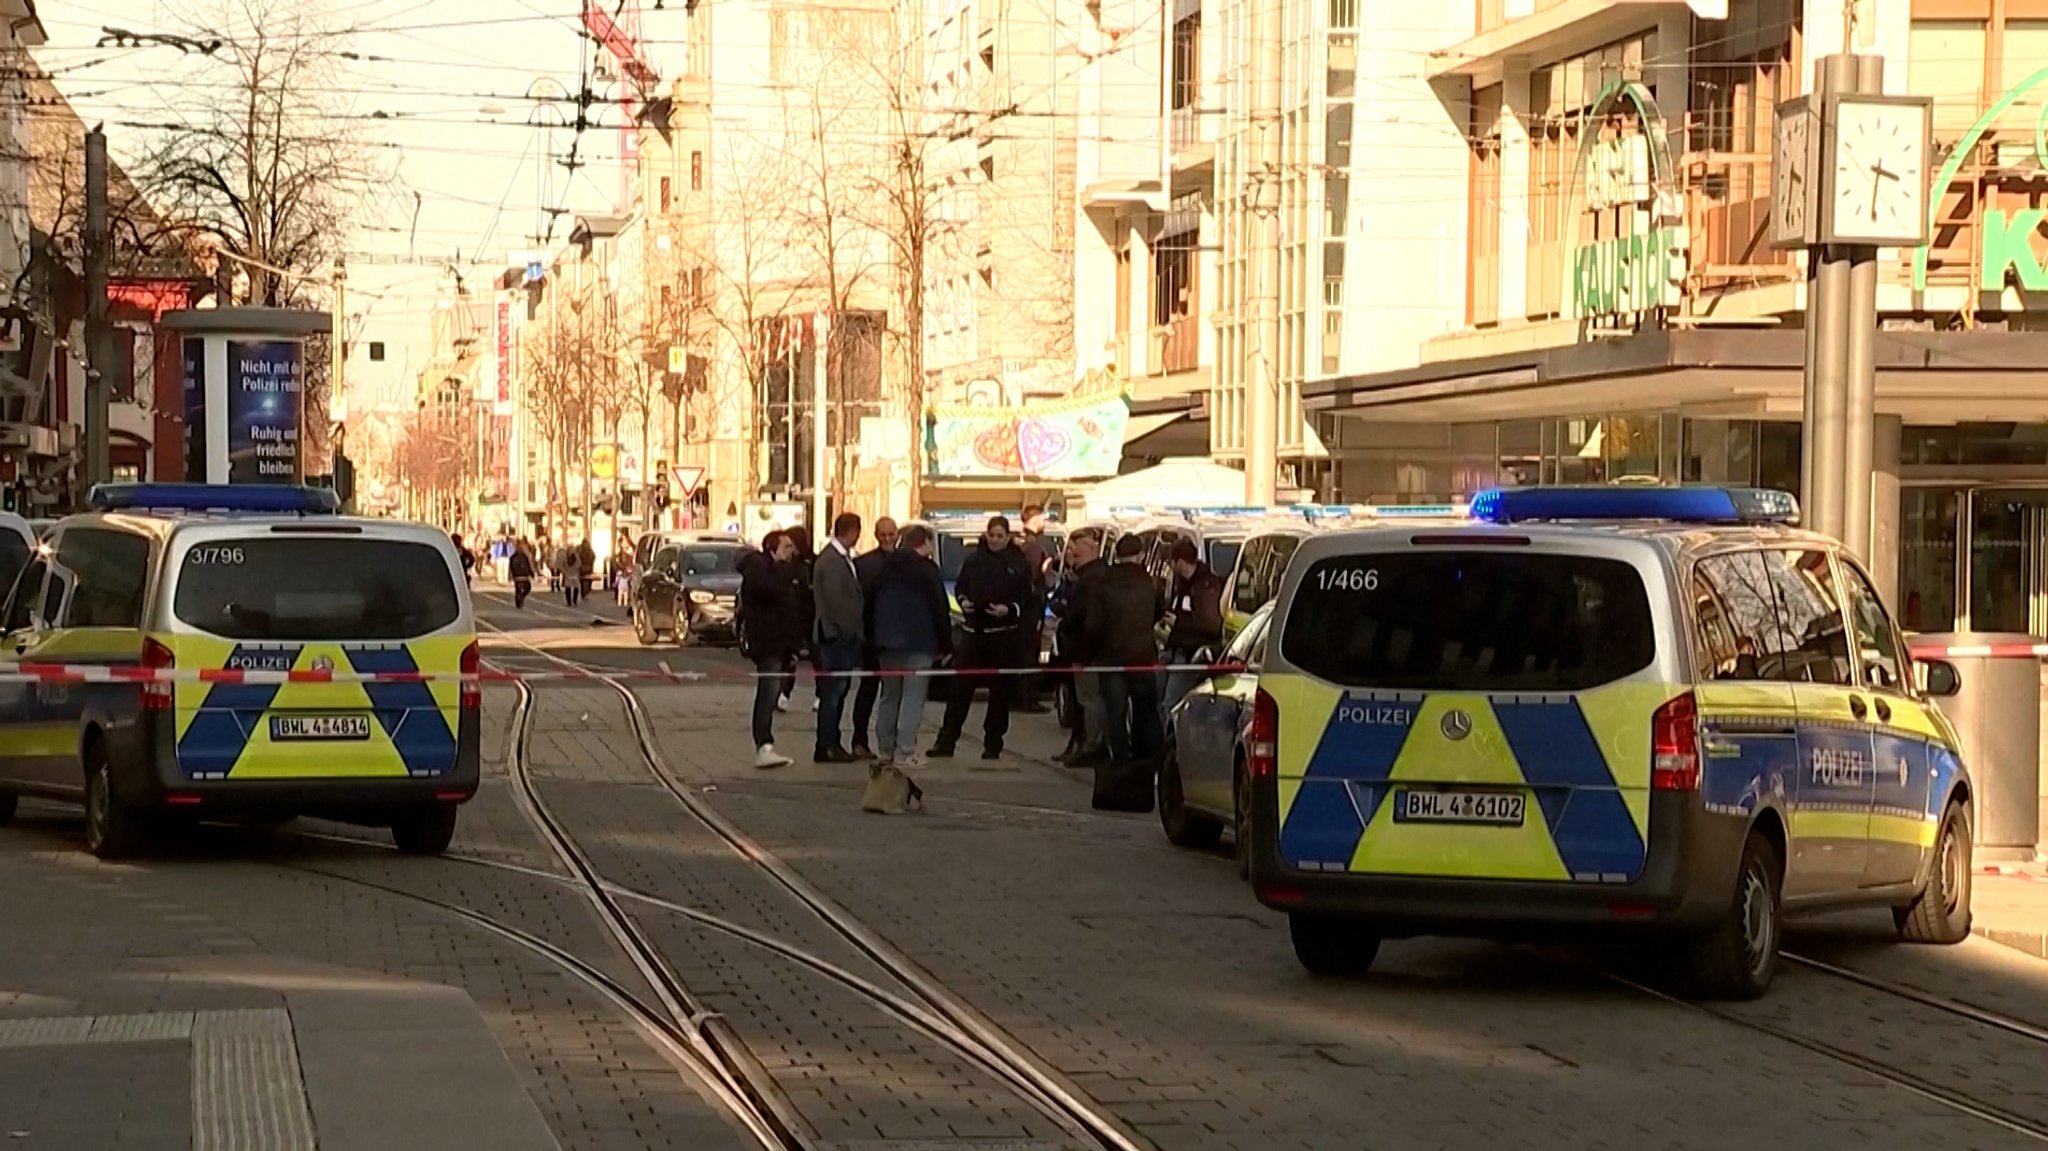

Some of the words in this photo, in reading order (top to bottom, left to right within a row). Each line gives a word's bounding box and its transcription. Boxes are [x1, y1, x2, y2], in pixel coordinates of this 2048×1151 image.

[1980, 208, 2048, 291] K
[241, 360, 271, 374] Nicht
[273, 361, 290, 374] mit
[242, 376, 279, 392] Polizei
[251, 426, 282, 442] Ruhig
[259, 460, 295, 474] bleiben
[191, 547, 245, 565] 3/796
[1316, 568, 1379, 591] 1/466
[230, 655, 291, 671] POLIZEI
[1338, 706, 1411, 726] POLIZEI
[281, 717, 310, 738] BWL
[1811, 746, 1863, 787] POLIZEI
[1408, 792, 1444, 816] BWL
